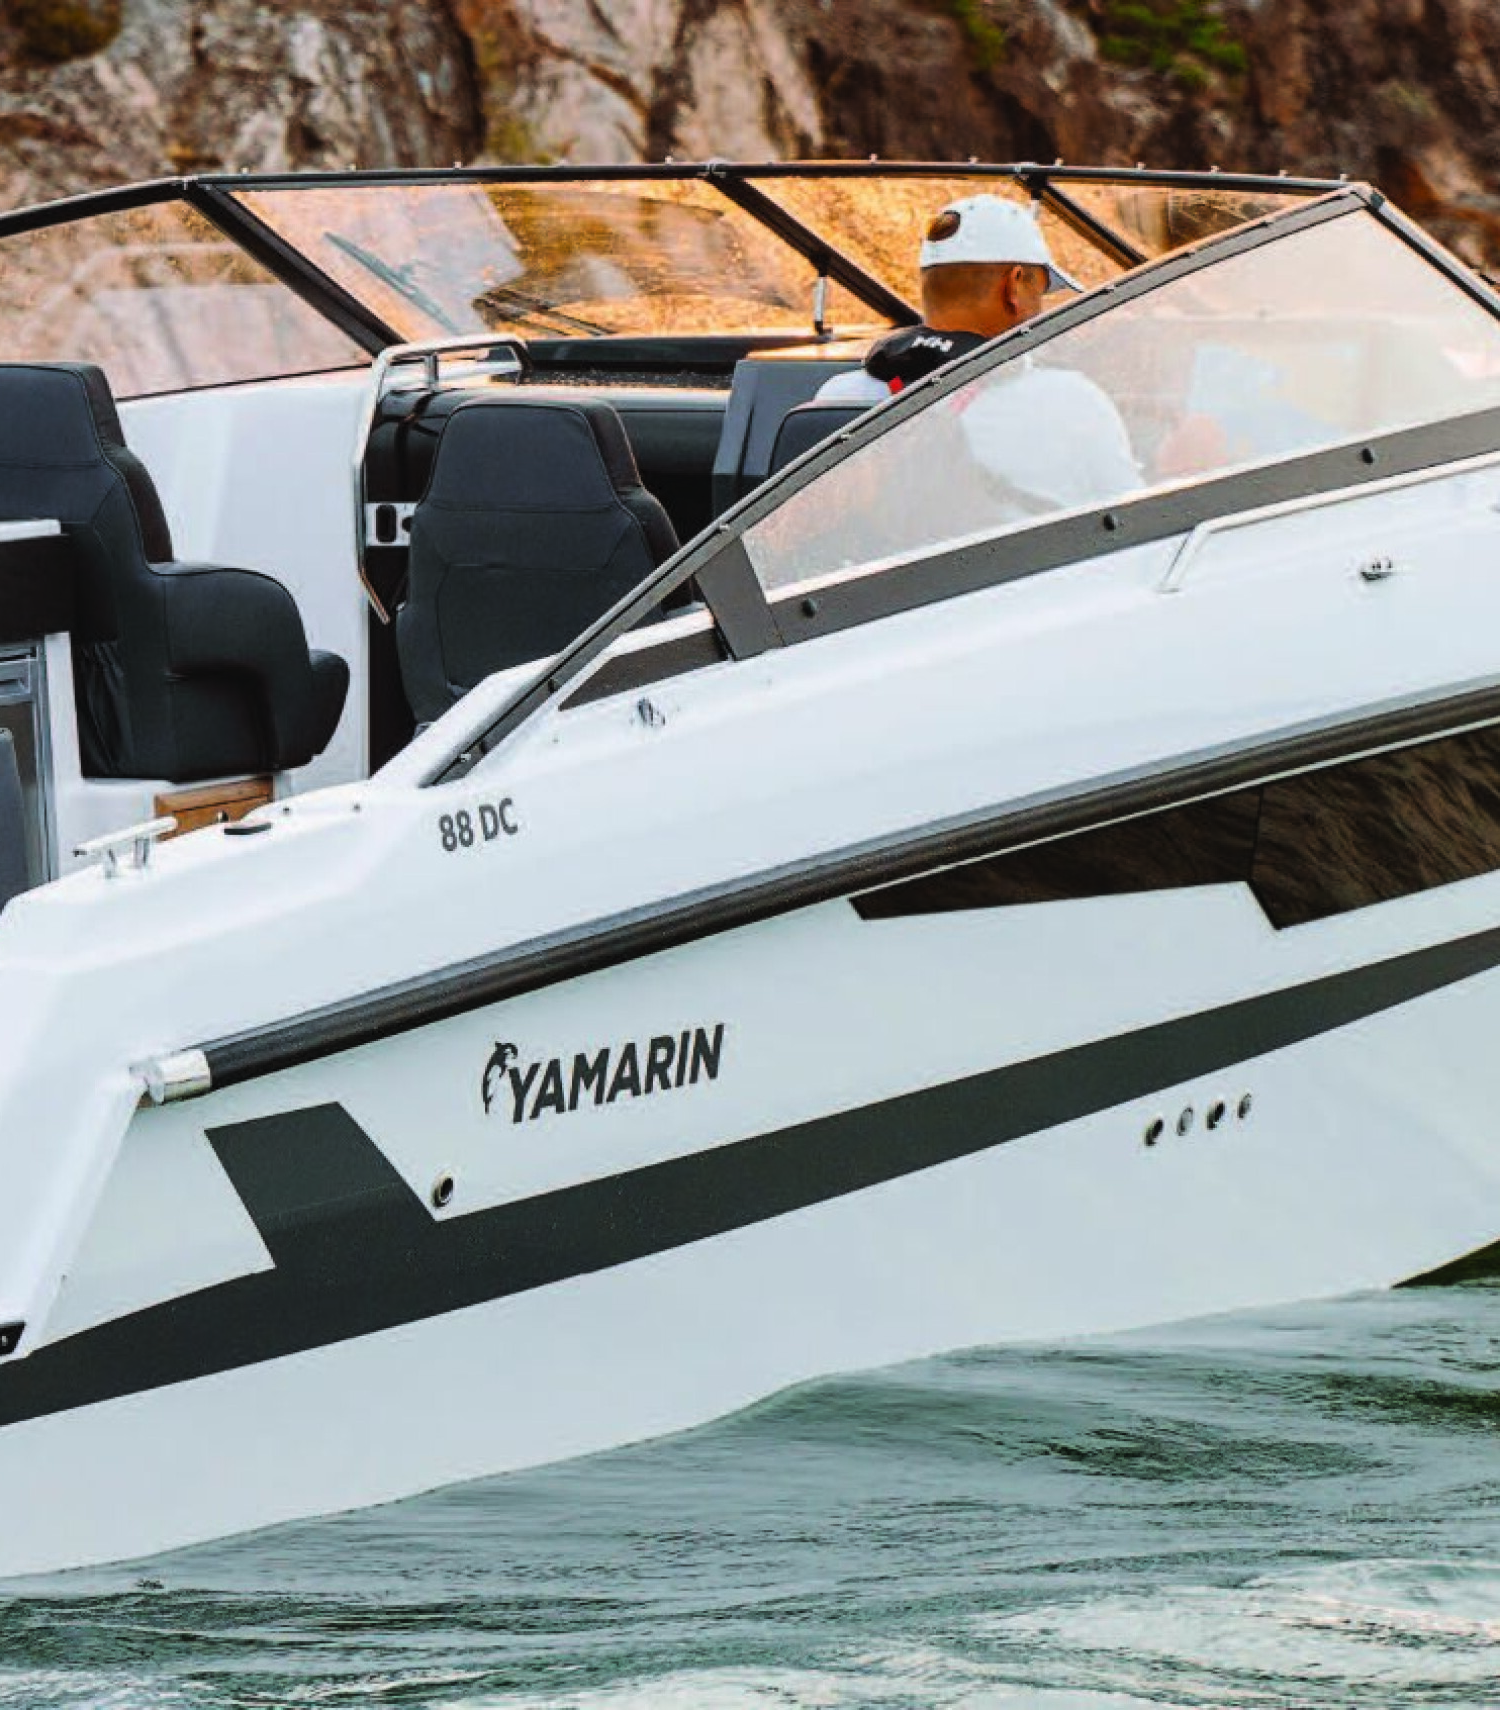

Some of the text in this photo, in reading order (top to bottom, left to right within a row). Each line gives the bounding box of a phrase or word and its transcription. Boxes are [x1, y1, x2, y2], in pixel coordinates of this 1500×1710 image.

[438, 798, 519, 852] 88 DC
[507, 1022, 725, 1125] YAMARIN
